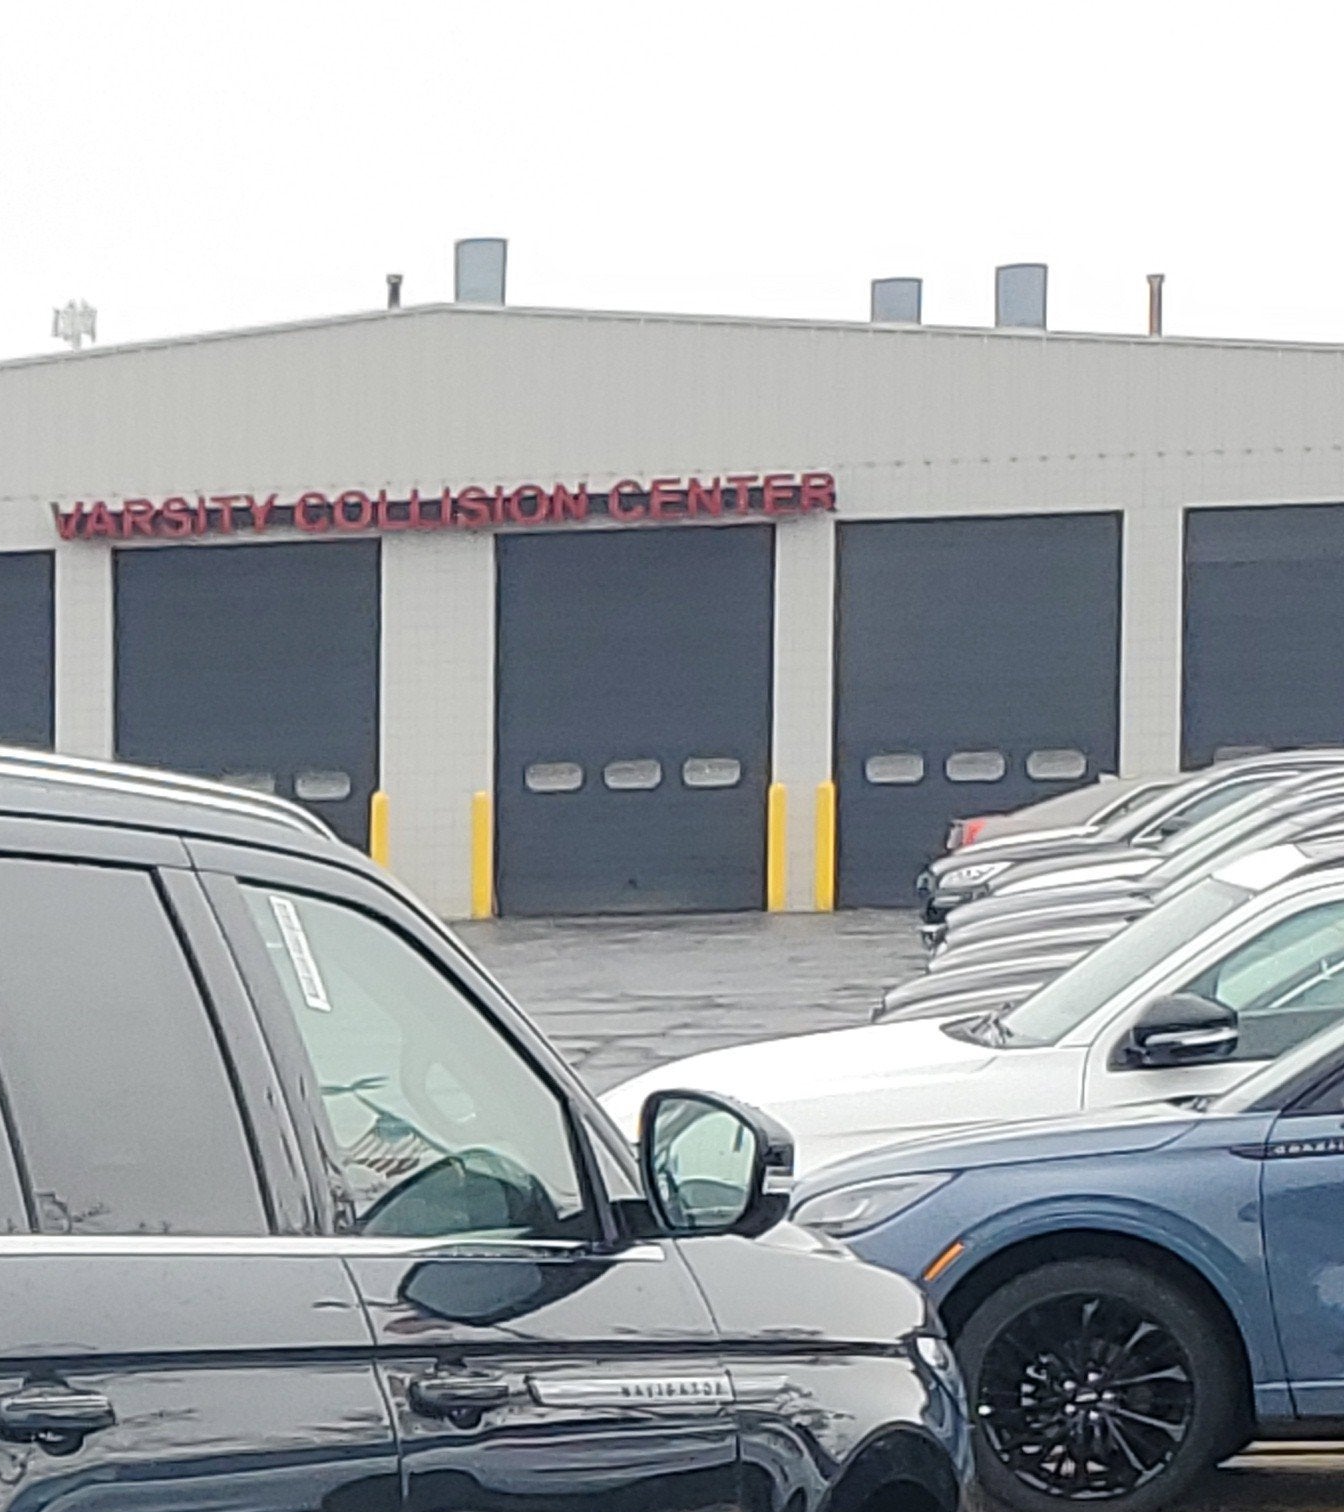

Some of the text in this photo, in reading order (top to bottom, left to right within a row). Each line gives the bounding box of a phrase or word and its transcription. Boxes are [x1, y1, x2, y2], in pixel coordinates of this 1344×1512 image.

[49, 471, 837, 541] VARSITY COLLISION CENTER
